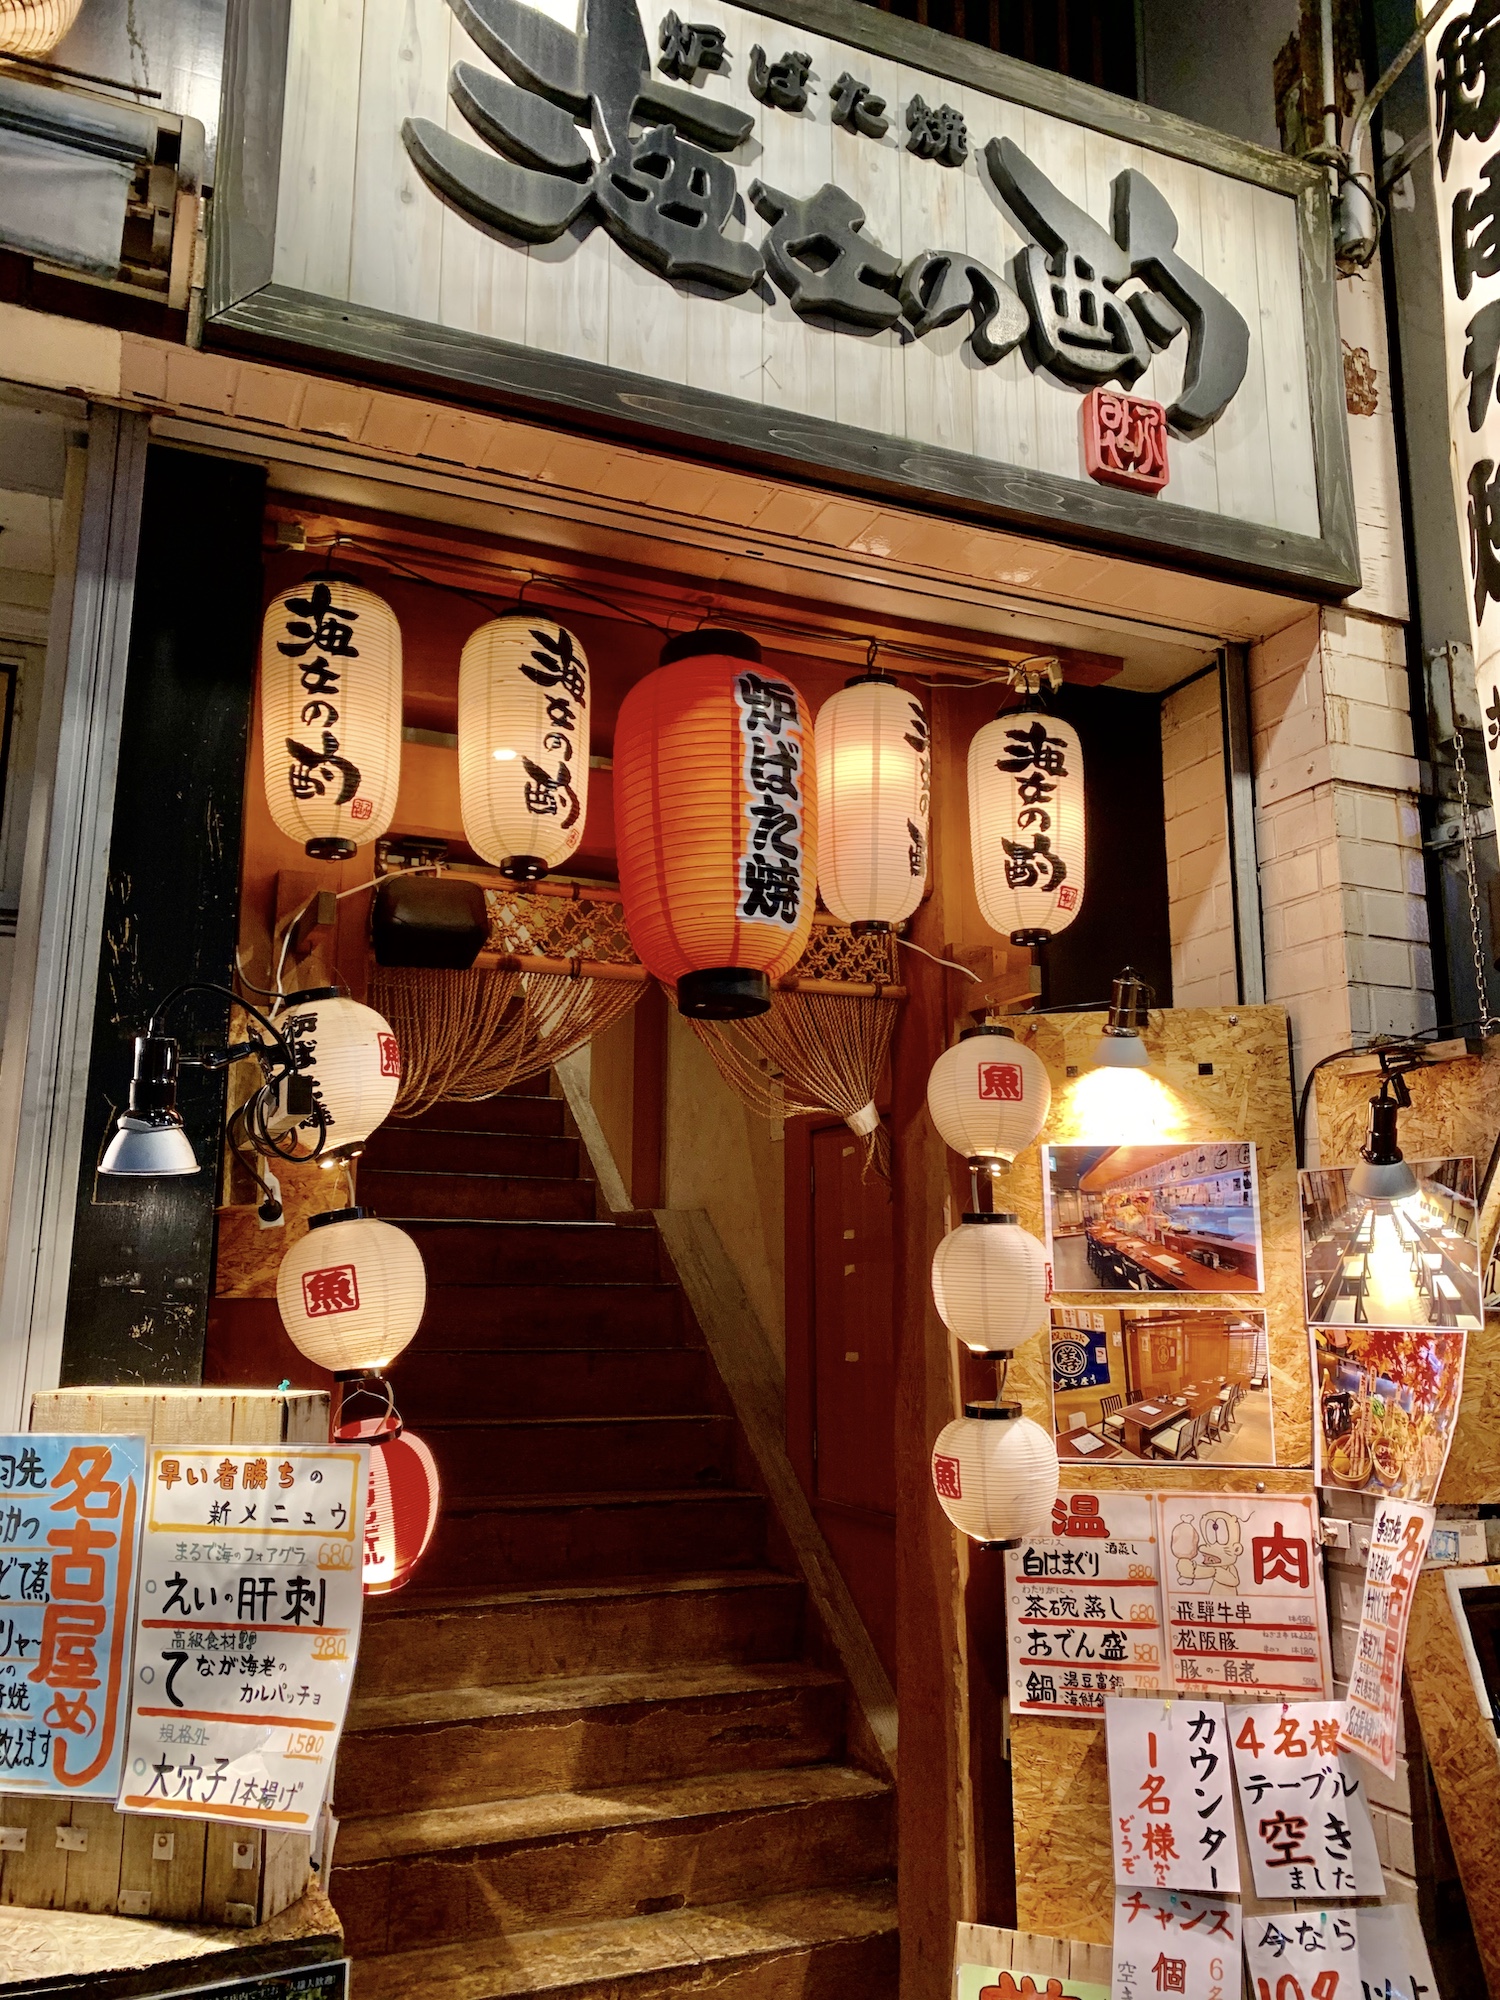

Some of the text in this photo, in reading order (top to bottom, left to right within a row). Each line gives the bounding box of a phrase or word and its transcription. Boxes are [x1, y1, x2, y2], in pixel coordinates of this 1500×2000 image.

[658, 8, 971, 168] 炉ばた焼
[737, 673, 800, 924] 炉ばた焼
[983, 1063, 1020, 1099] 魚
[305, 1270, 356, 1315] 魚
[158, 1458, 323, 1490] 早い者勝ちの
[936, 1459, 958, 1495] 魚
[0, 1505, 41, 1543] かつ
[207, 1500, 347, 1530] 新メニュウ
[1051, 1494, 1111, 1539] 温
[175, 1541, 353, 1566] まるで海のフォアグラ 680
[1022, 1547, 1154, 1579] 白はまぐり 880
[1104, 1542, 1138, 1555] 酒蒸し
[1251, 1521, 1310, 1589] 肉
[27, 1446, 137, 1787] 名古屋めし
[162, 1571, 326, 1627] えいの肝刺
[1025, 1594, 1155, 1621] 茶碗蒸し 680
[1177, 1601, 1252, 1623] 飛騨牛串
[314, 1636, 346, 1656] 980
[1027, 1628, 1159, 1662] おでん盛 580
[1177, 1629, 1240, 1651] 松阪豚
[162, 1651, 288, 1707] てなが海老の
[240, 1683, 321, 1706] カルパッチョ
[1026, 1671, 1057, 1703] 鍋
[1134, 1675, 1160, 1689] 780
[159, 1723, 325, 1755] 規格外 1,580
[1235, 1717, 1352, 1759] 4名様
[144, 1752, 304, 1811] 大穴子 1本揚げ
[1185, 1710, 1228, 1889] カウンター
[1243, 1766, 1360, 1804] テーブル
[1117, 1815, 1141, 1876] どうぞ
[1121, 1891, 1234, 1940] チャンス
[1258, 1918, 1356, 1958] 今なら
[1150, 1951, 1188, 1995] 個
